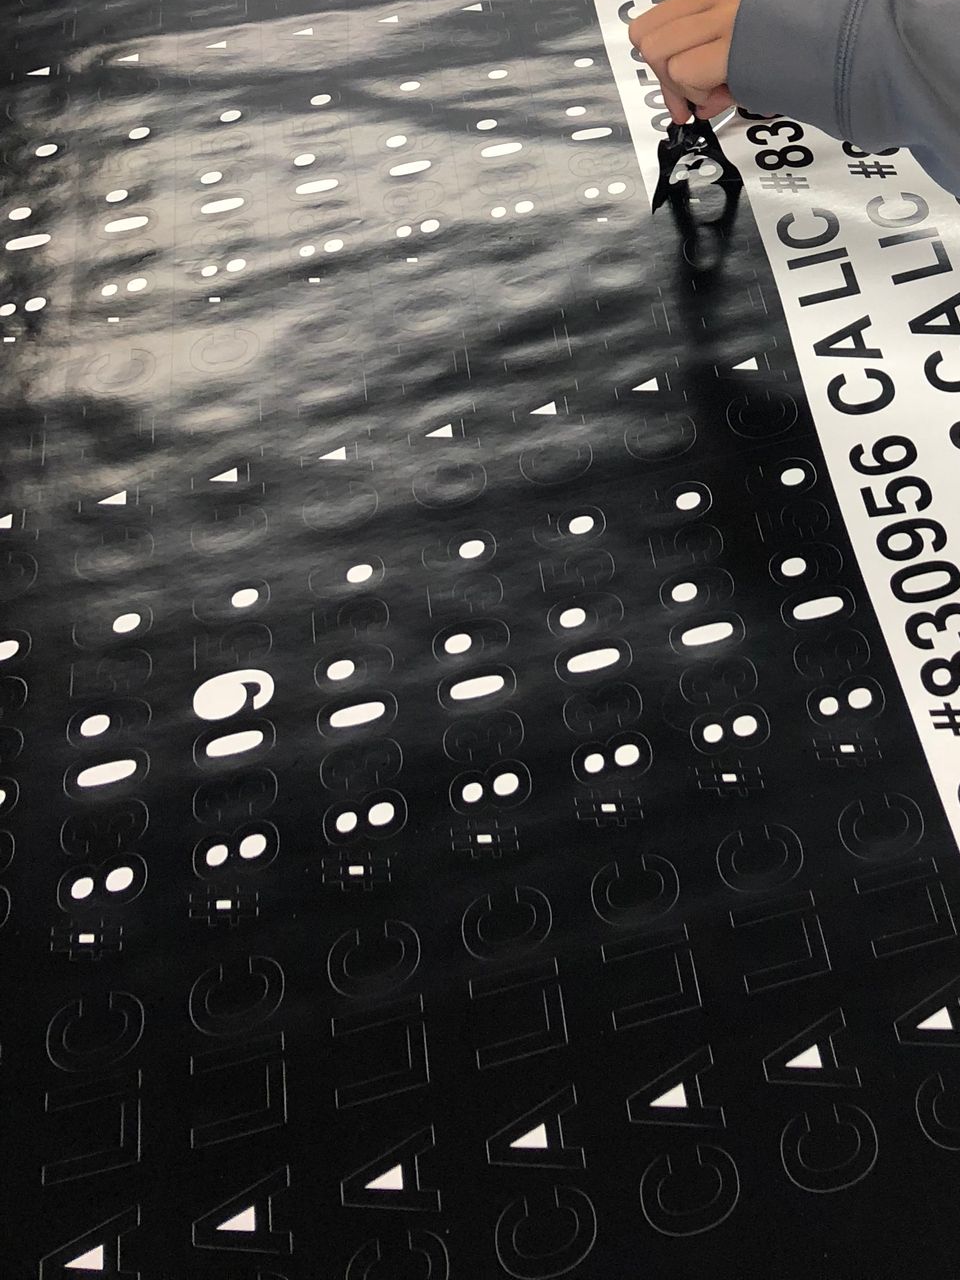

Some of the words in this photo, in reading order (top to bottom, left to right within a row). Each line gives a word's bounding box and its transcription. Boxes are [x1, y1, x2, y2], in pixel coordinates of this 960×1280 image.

[776, 207, 861, 308] LIC
[866, 192, 953, 286] LIC
[813, 315, 895, 416] CA
